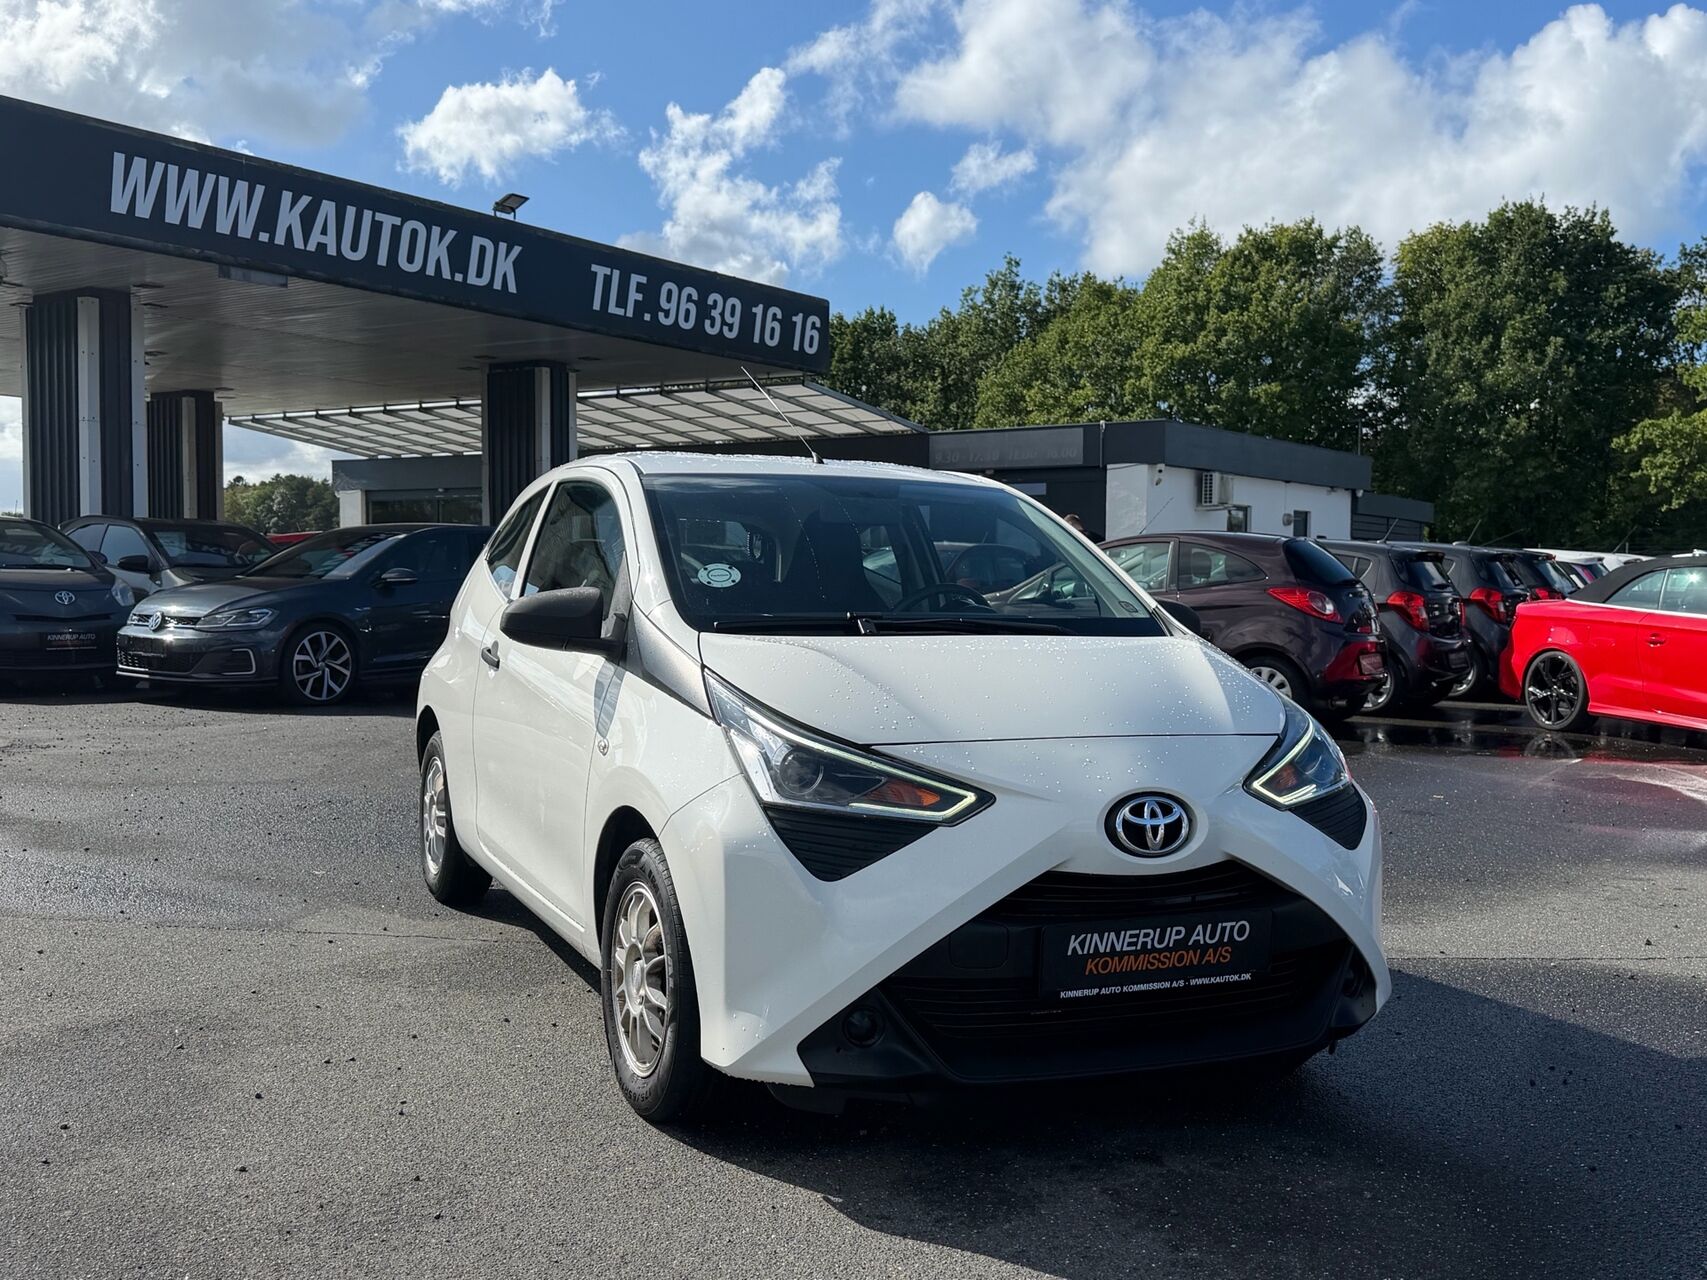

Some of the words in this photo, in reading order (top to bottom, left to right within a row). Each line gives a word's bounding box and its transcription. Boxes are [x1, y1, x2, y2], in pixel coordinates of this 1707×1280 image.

[111, 151, 523, 294] WWW.KAUTOK.DK
[591, 264, 651, 322] TLF.
[658, 281, 699, 330] 96
[704, 292, 742, 340] 39
[752, 303, 783, 347] 16
[792, 312, 821, 355] 16
[1067, 926, 1186, 956] KINNERUP
[1188, 920, 1250, 946] AUTO
[1085, 949, 1201, 976] KOMMISSION
[1202, 946, 1232, 965] A/S
[1060, 987, 1100, 999] KINNERUP
[1100, 985, 1121, 995] AUTO
[1122, 980, 1171, 993] KOMMISSION
[1171, 978, 1185, 988] A/S
[1189, 972, 1252, 986] WWW.KAUTOK.DK
